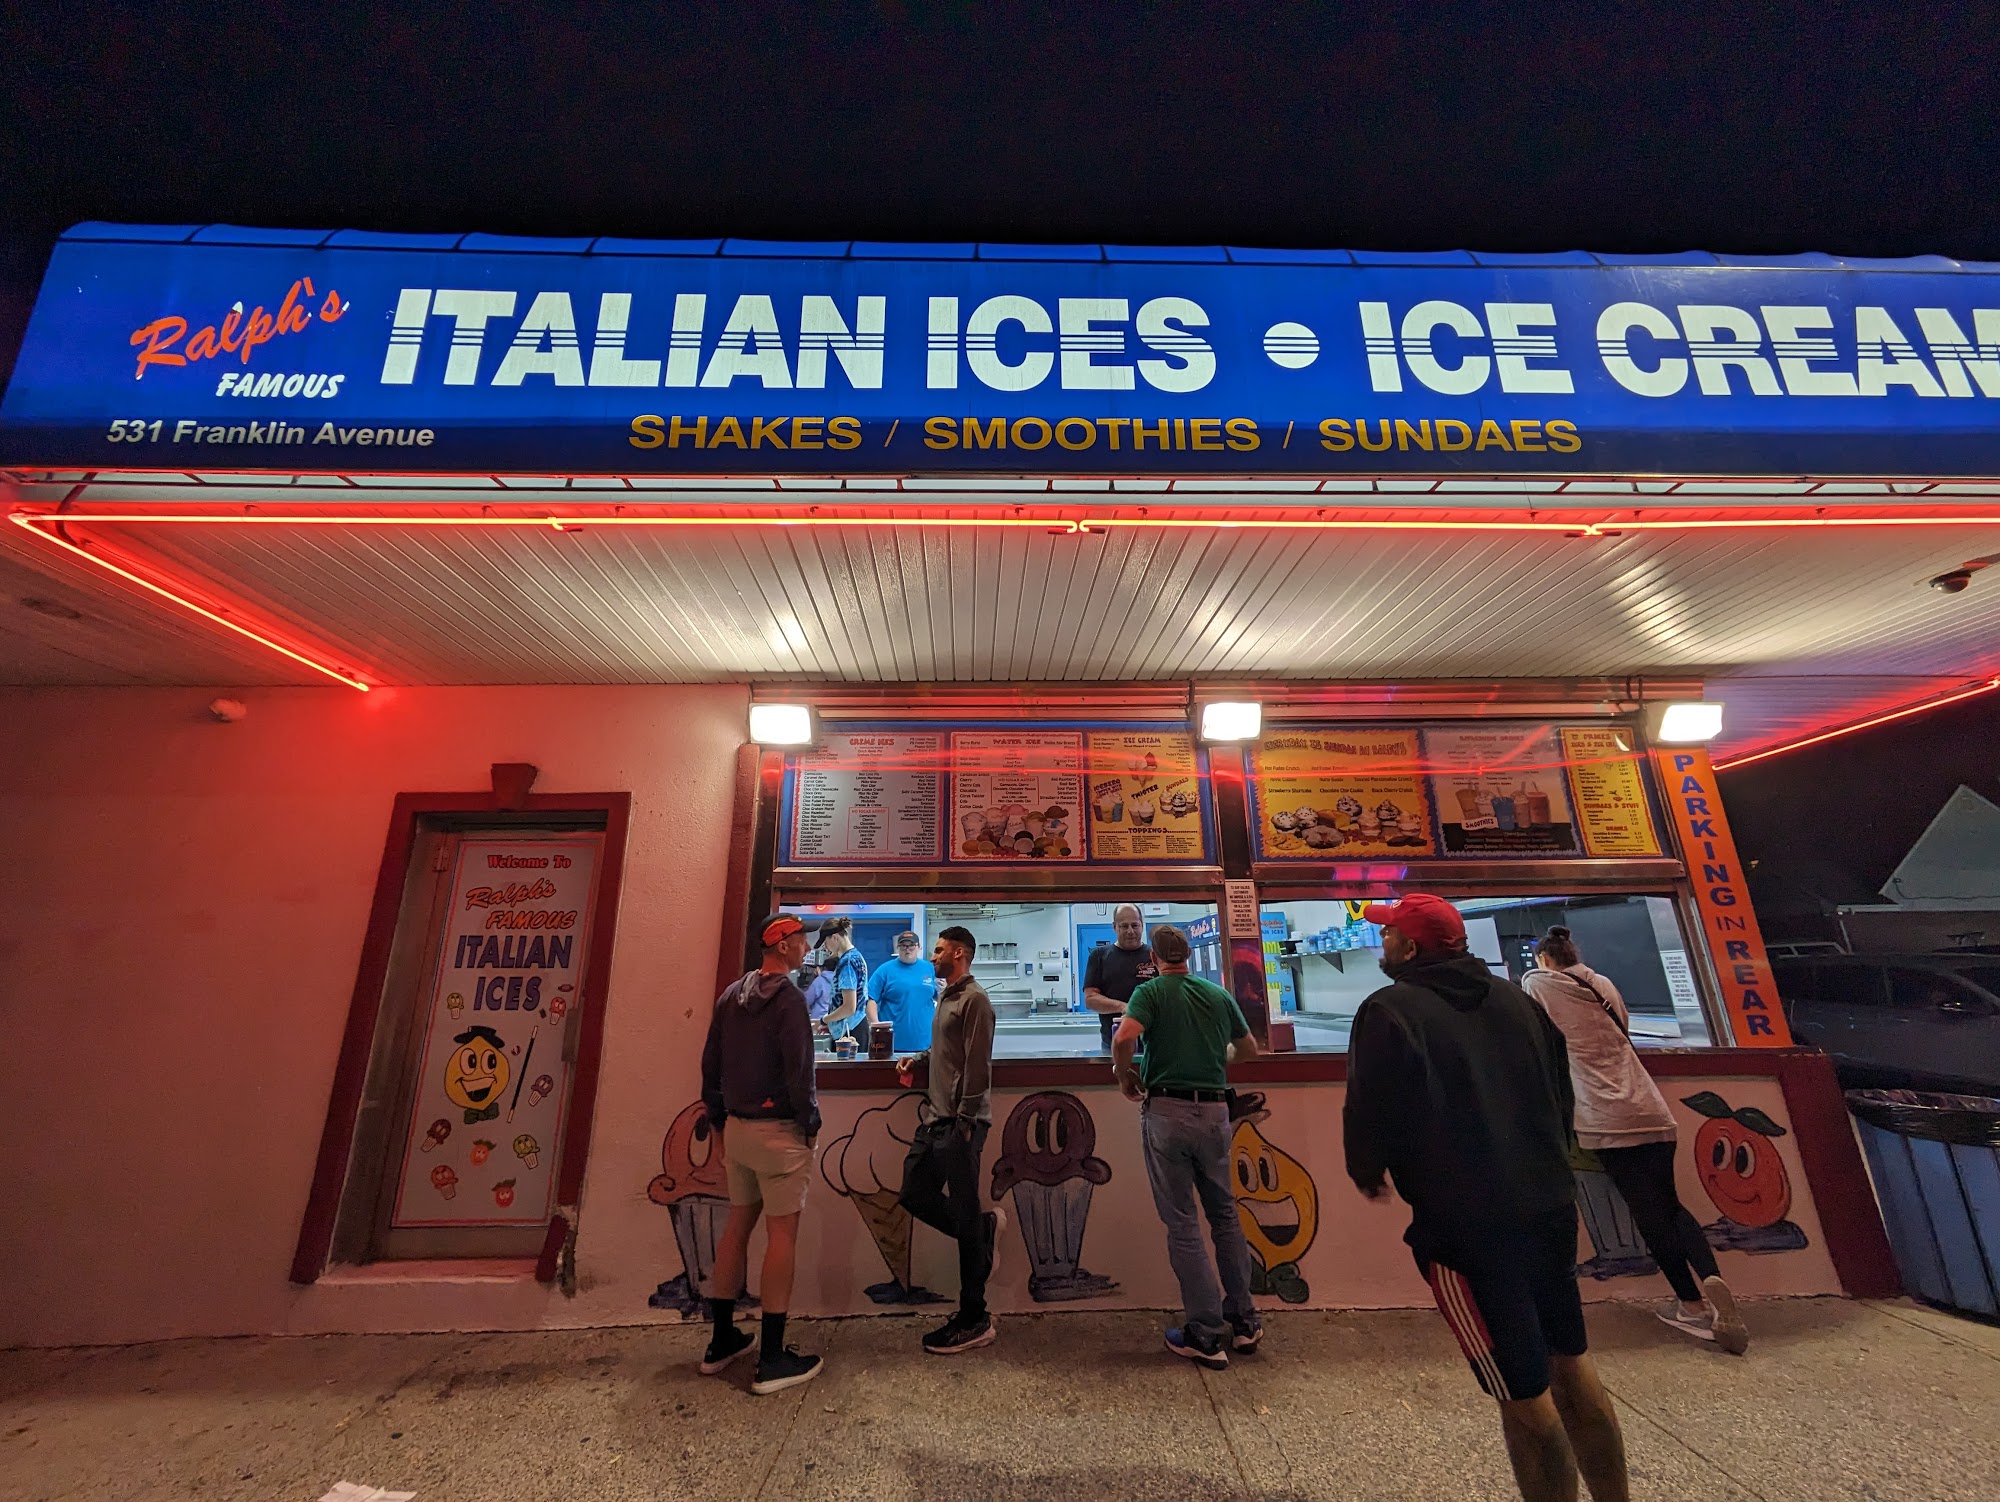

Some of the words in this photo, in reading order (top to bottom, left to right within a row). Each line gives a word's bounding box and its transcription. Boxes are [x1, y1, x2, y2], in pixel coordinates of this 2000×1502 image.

[130, 277, 349, 379] Ralph's
[380, 288, 886, 389] ITALIAN
[925, 295, 1216, 393] ICES
[1358, 300, 1575, 395] ICE
[216, 372, 345, 398] FAMOUS
[106, 419, 163, 444] 531
[172, 420, 307, 445] Franklin
[312, 422, 435, 447] Avenue
[629, 414, 862, 450] SHAKES
[923, 416, 1261, 451] SMOOTHIES
[1320, 419, 1582, 453] SUNDAES
[1131, 784, 1159, 800] TWISTER
[1465, 818, 1495, 828] SMOOTHIES
[1674, 754, 1736, 907] PARKING
[487, 854, 548, 869] Welcome
[553, 855, 572, 869] To
[465, 878, 557, 911] Ralph's
[486, 910, 578, 930] FAMOUS
[1716, 916, 1746, 931] IN
[454, 935, 573, 969] ITALIAN
[473, 976, 543, 1011] ICES
[1726, 940, 1775, 1036] REAR
